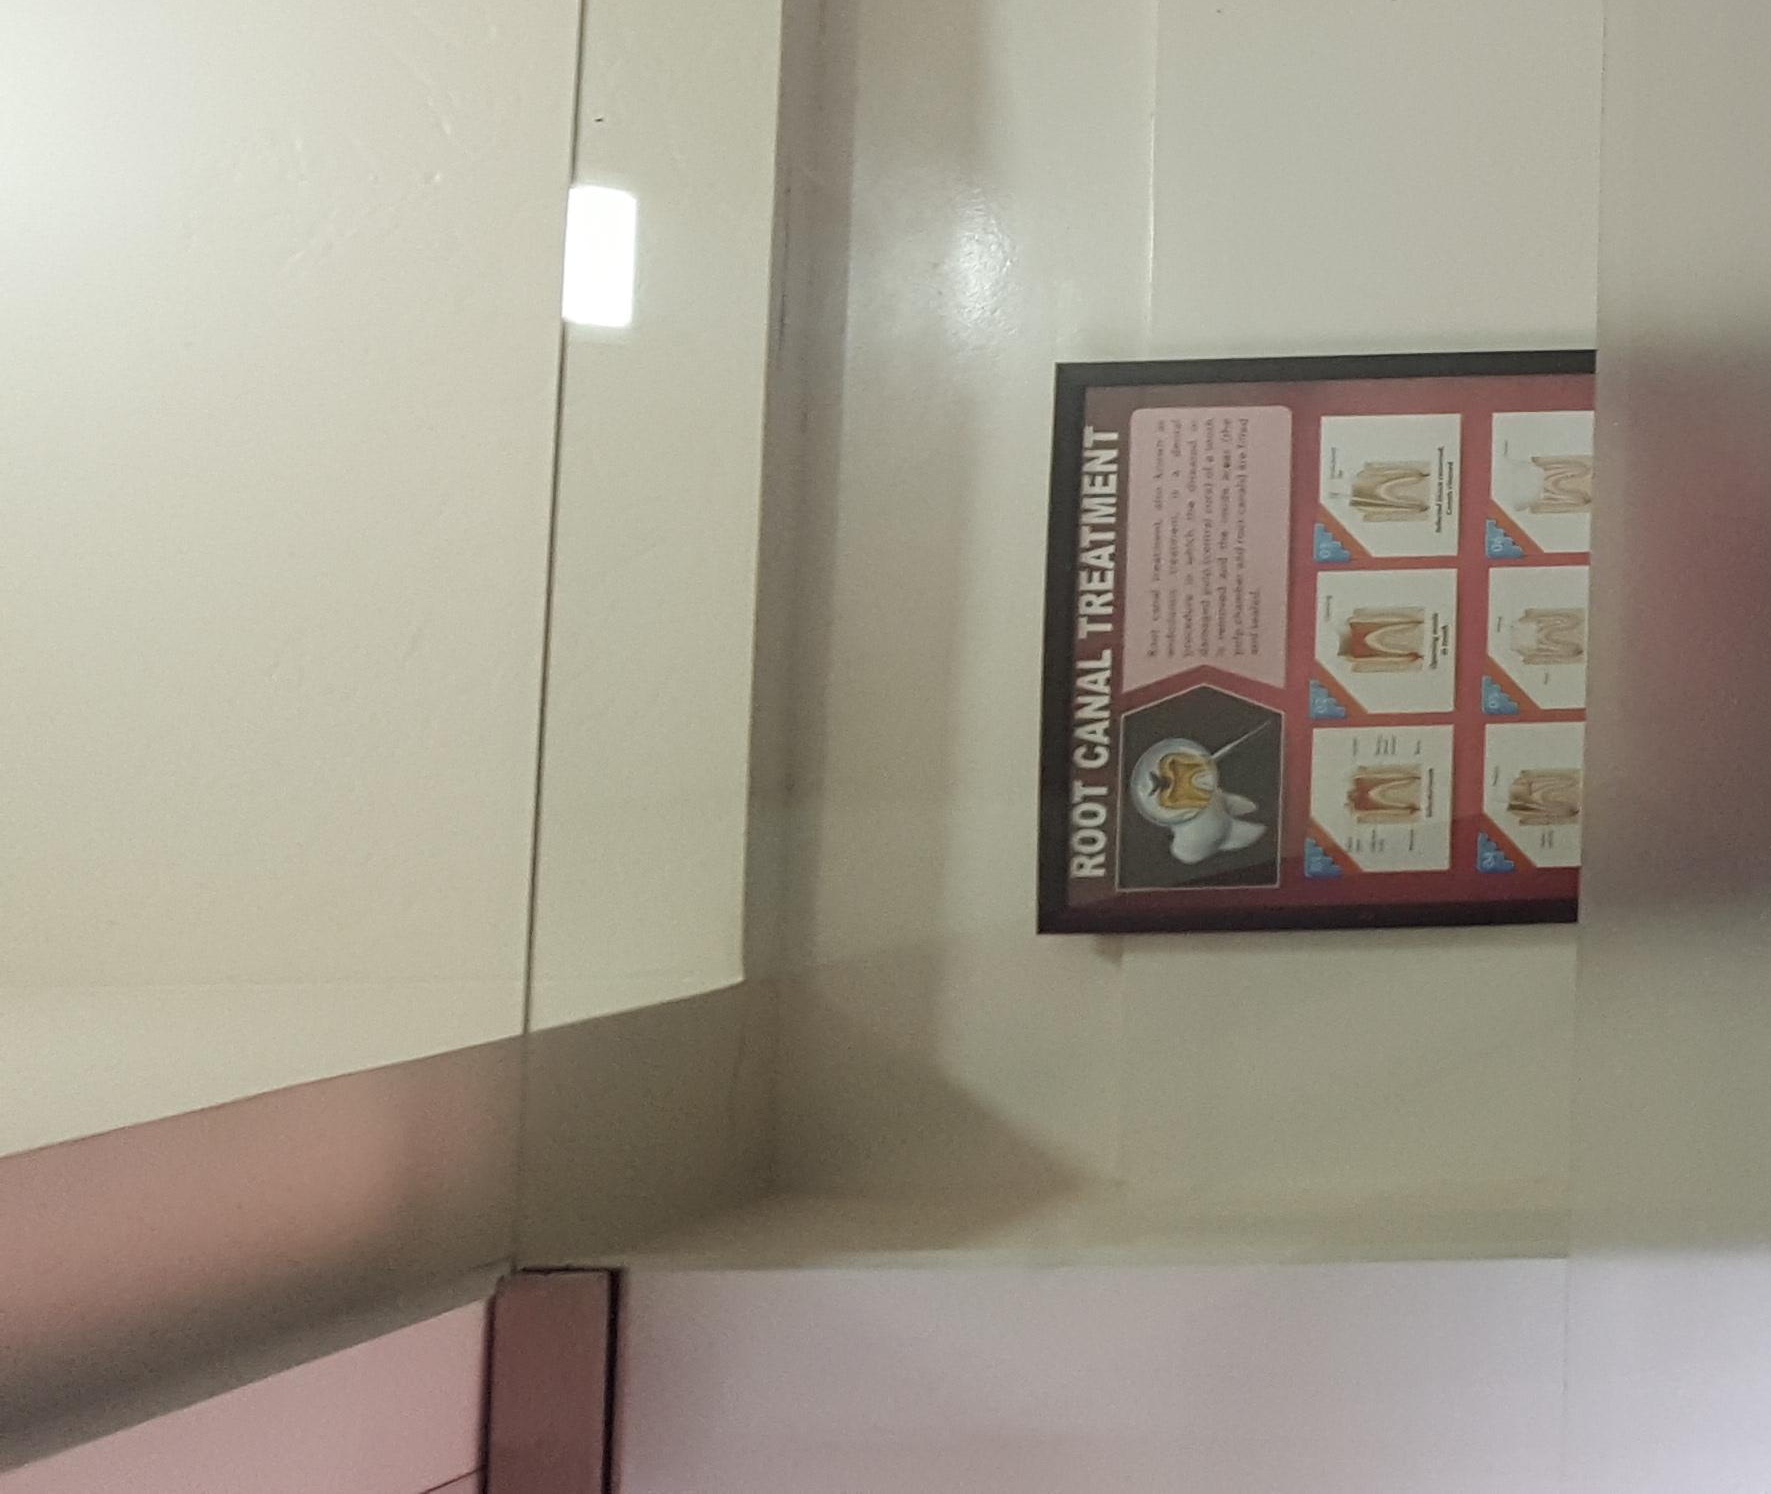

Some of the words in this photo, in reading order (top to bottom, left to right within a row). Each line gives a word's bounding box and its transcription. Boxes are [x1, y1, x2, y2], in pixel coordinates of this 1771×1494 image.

[1078, 426, 1118, 638] TREATMENT
[1073, 650, 1112, 769] CANAL
[1070, 780, 1108, 878] ROOT
